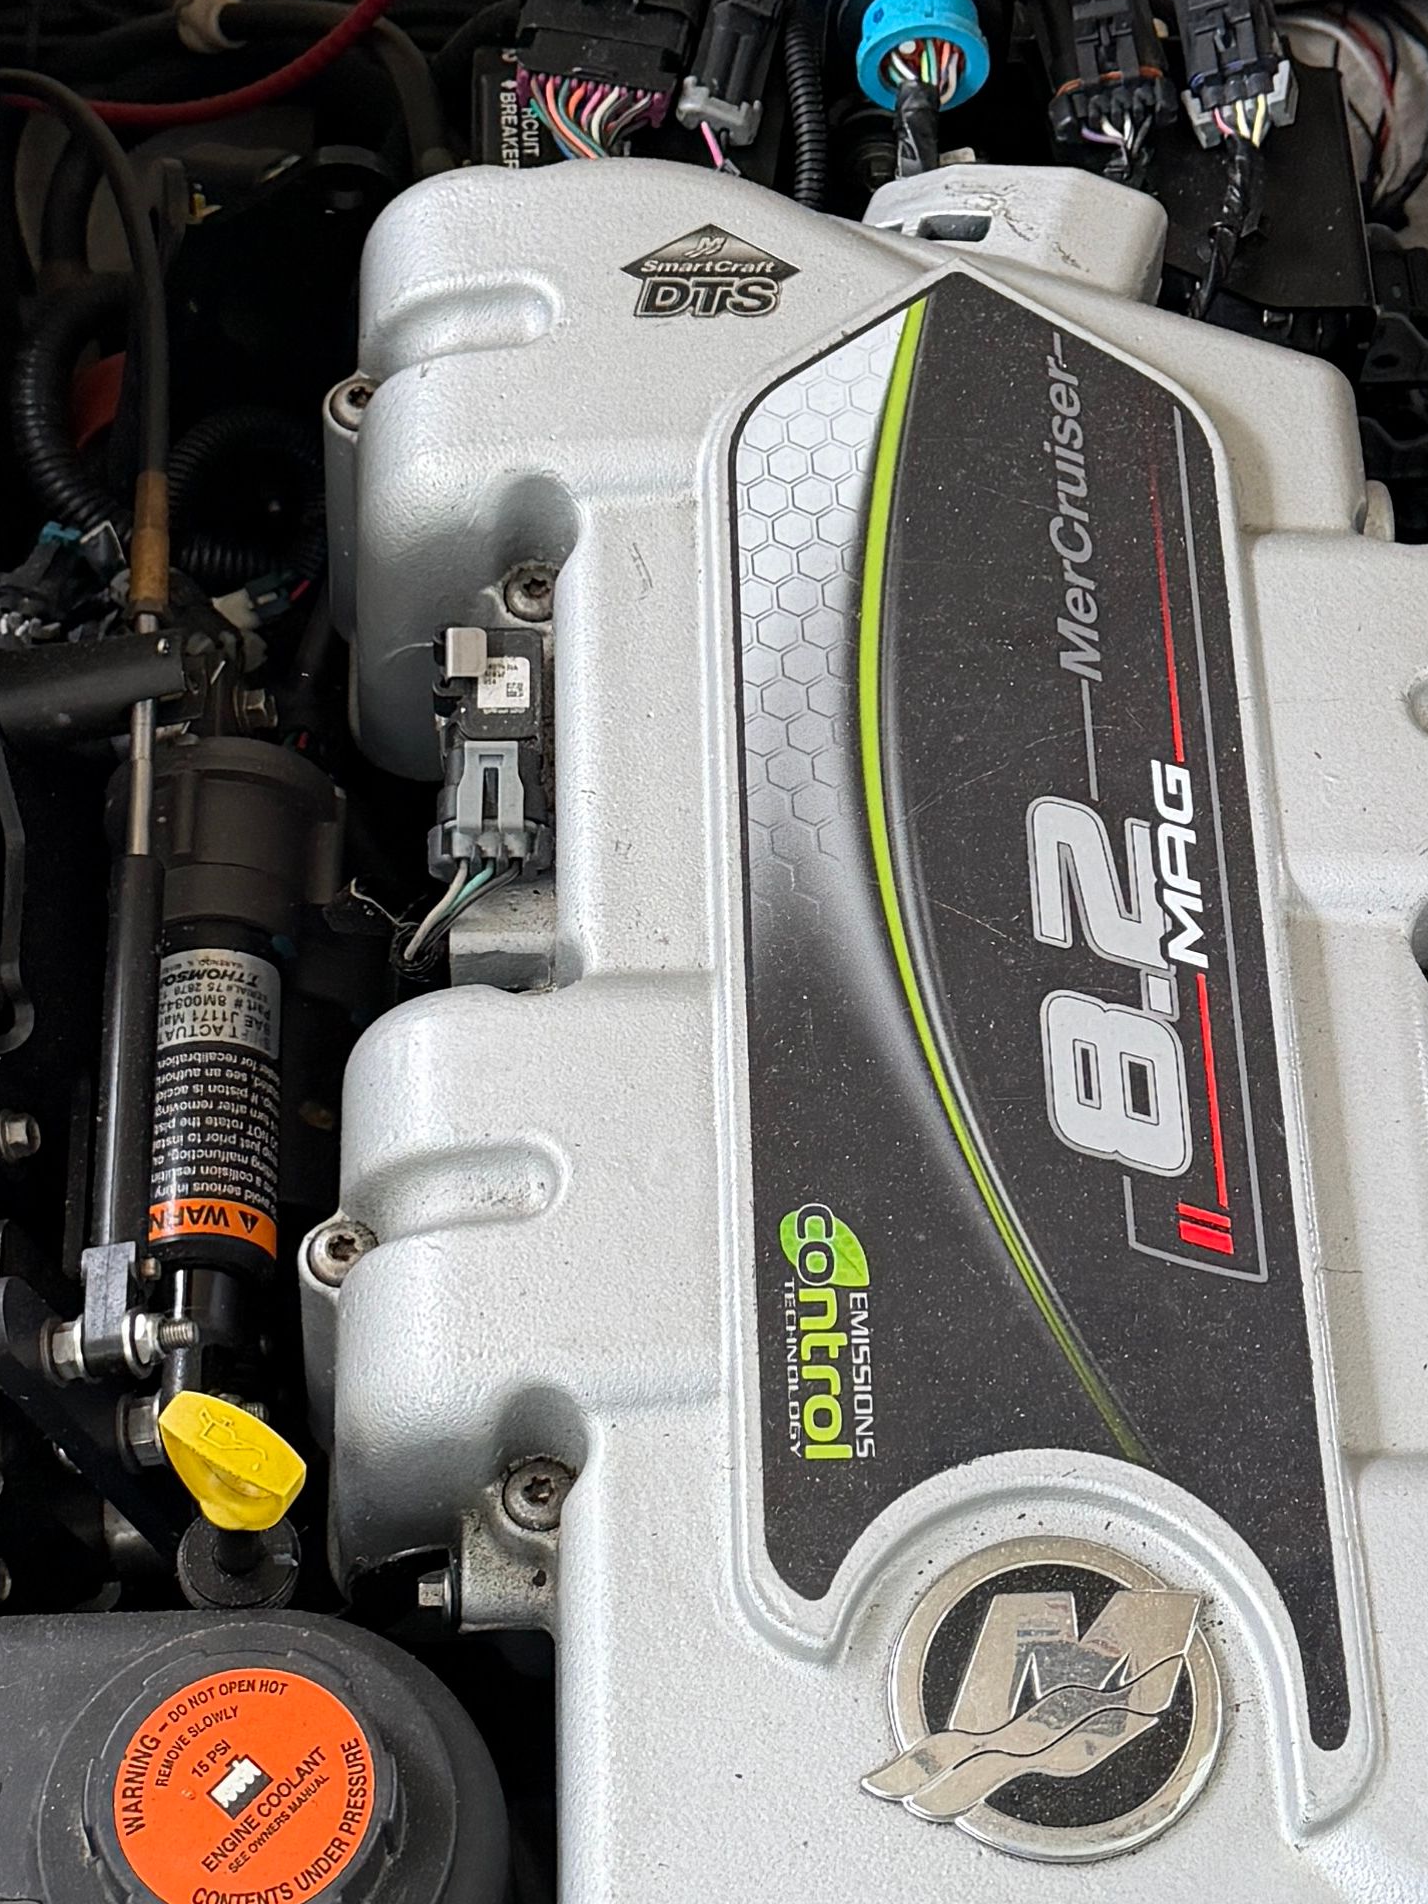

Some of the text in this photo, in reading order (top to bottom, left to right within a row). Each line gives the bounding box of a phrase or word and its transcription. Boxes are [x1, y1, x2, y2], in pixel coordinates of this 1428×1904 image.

[640, 259, 775, 275] SmartCraft
[633, 276, 782, 318] DTS
[1043, 362, 1105, 683] MerCruiser
[1152, 760, 1212, 970] MAG
[1026, 795, 1193, 1177] 8.2
[192, 1009, 239, 1023] J1171
[204, 1068, 221, 1082] an
[226, 1069, 248, 1083] see
[192, 1084, 204, 1096] is
[208, 1084, 248, 1099] piston
[217, 1100, 247, 1114] after
[180, 1116, 200, 1128] the
[205, 1116, 244, 1130] rotate
[188, 1133, 202, 1143] to
[205, 1132, 237, 1146] prior
[193, 1182, 241, 1195] serious
[201, 1167, 253, 1183] collision
[795, 1203, 853, 1459] control
[783, 1277, 801, 1458] TECHNOLOGY
[849, 1292, 875, 1458] EMISSIONS
[123, 1679, 289, 1837] WARNING DO NOT OPEN HOT
[155, 1705, 239, 1788] REMOVE SLOWLY
[191, 1739, 232, 1779] 15 PSI
[201, 1746, 327, 1873] ENGINE COOLANT
[227, 1773, 330, 1874] SEE OWNERS MANUAL
[295, 1836, 350, 1892] UNDER
[338, 1737, 368, 1836] PRESSURE
